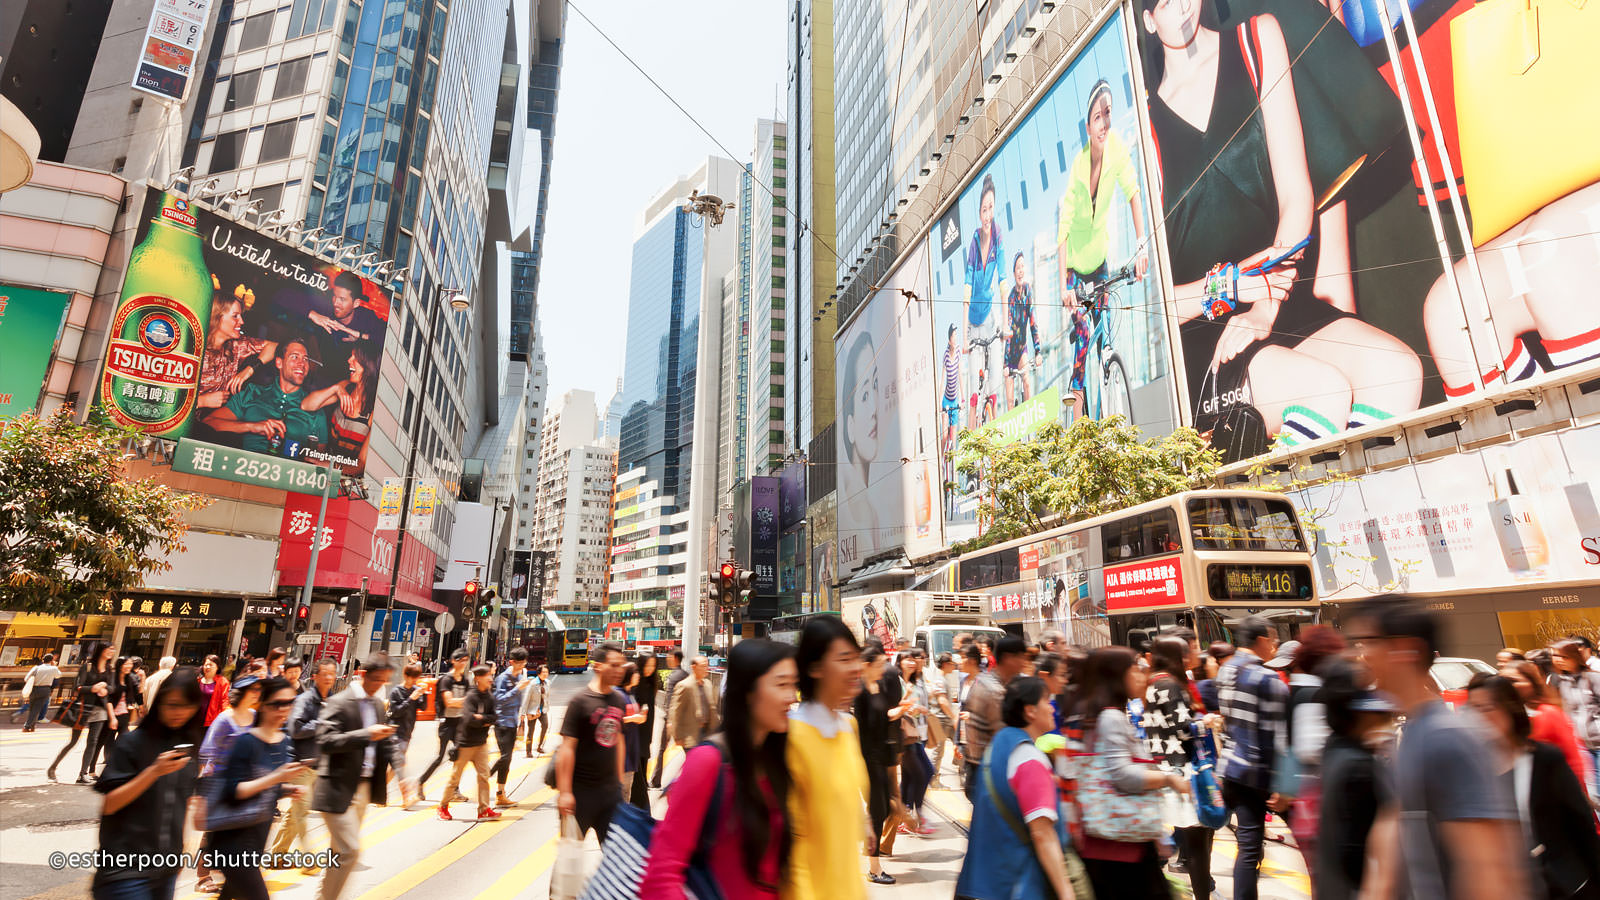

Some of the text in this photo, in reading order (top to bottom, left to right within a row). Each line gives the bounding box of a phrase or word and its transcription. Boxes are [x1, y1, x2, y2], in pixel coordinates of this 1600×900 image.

[162, 207, 197, 227] TSINGTAO
[211, 225, 329, 291] United in taste
[112, 347, 194, 380] TSINGTAO
[122, 381, 176, 404] 青島啤酒
[234, 457, 281, 482] 2523
[285, 468, 328, 490] 1840
[288, 510, 335, 552] 莎莎
[1106, 573, 1119, 587] AIA
[1264, 572, 1291, 593] 116
